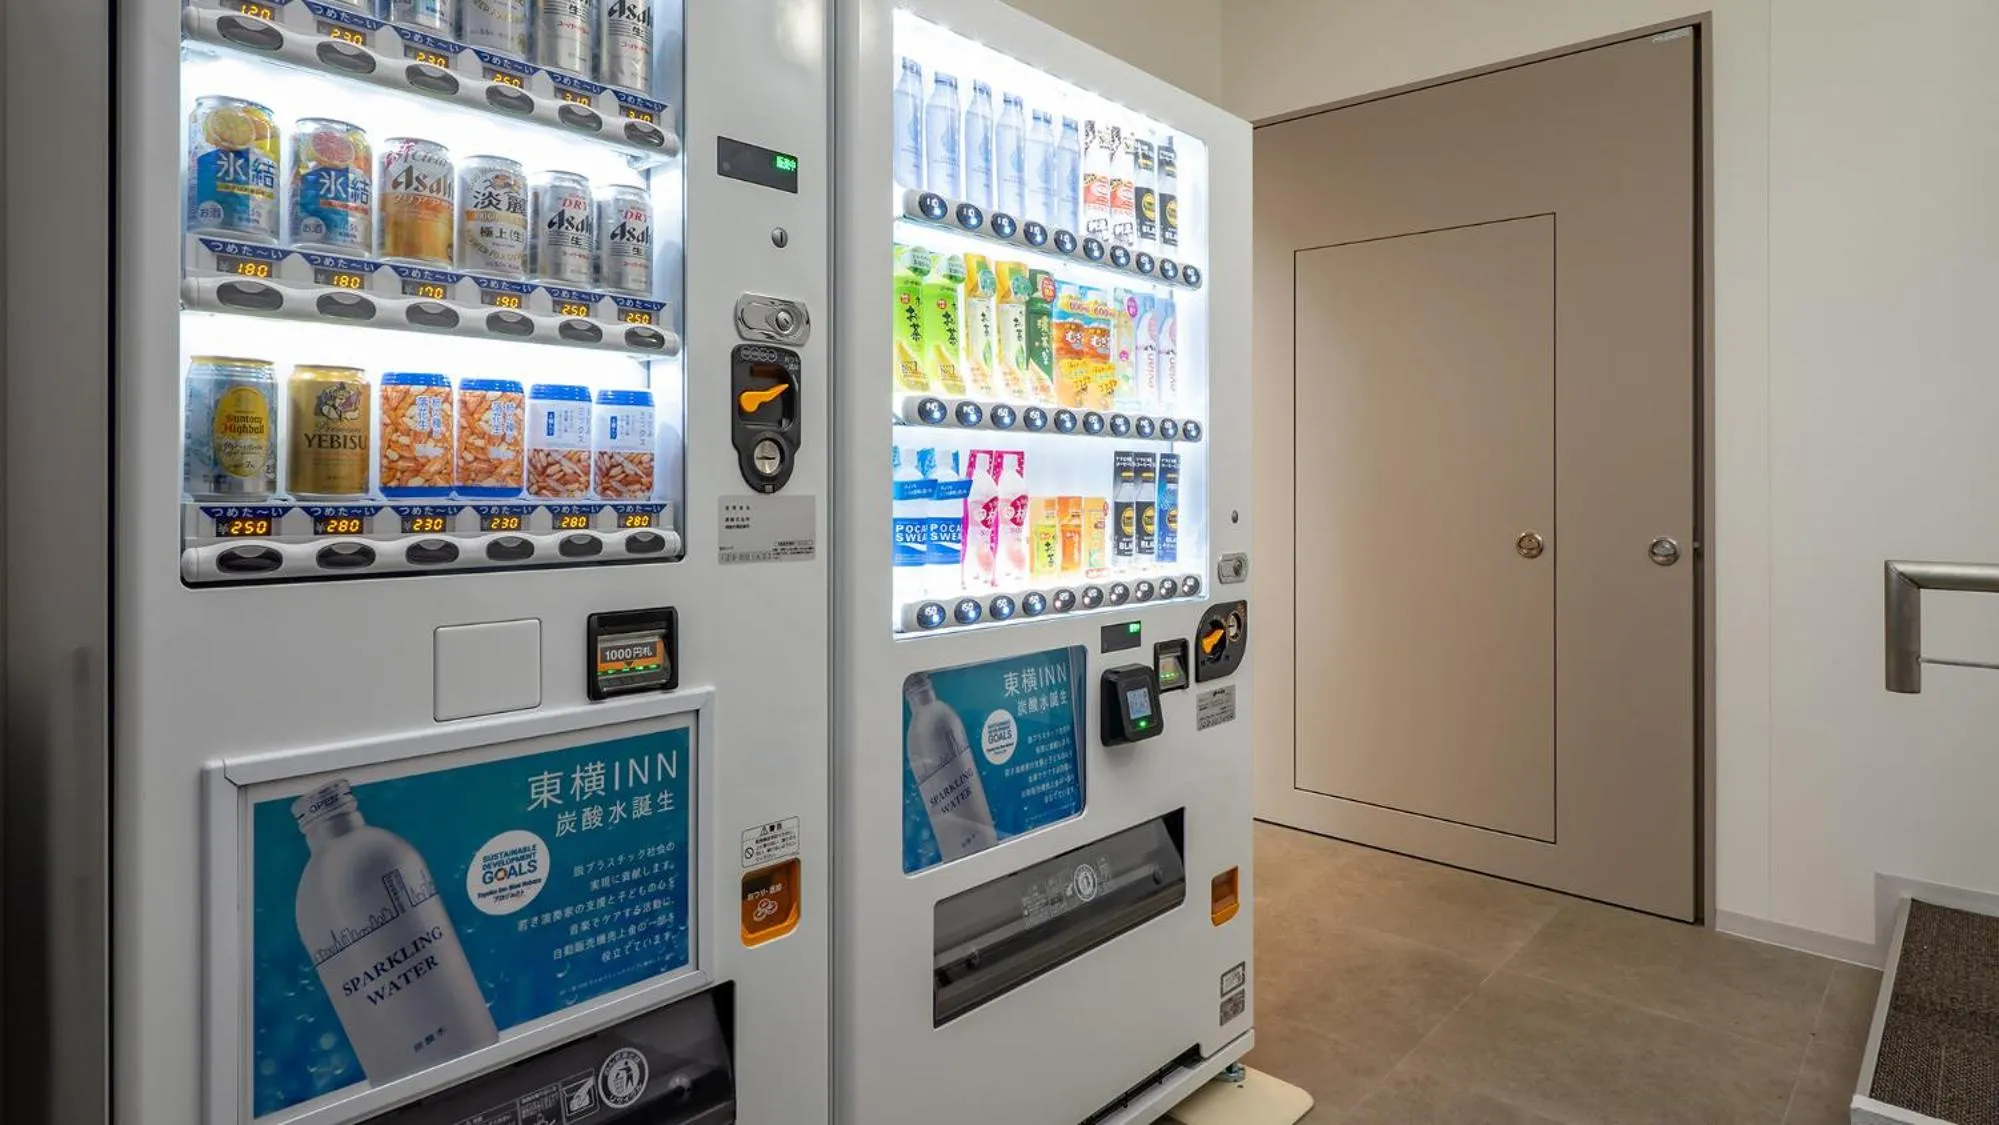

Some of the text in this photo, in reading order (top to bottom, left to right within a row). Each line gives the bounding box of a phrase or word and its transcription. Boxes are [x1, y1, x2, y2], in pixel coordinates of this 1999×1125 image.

[216, 152, 276, 188] 氷結
[319, 170, 369, 204] 氷結
[238, 262, 269, 278] 180
[333, 275, 361, 289] 180
[496, 296, 520, 308] 190
[561, 304, 587, 317] 250
[626, 312, 649, 324] 250
[303, 433, 368, 450] YEBISU
[604, 646, 652, 661] 1000円札
[555, 789, 675, 838] 炭酸水誕生
[482, 859, 538, 885] GOALS
[342, 926, 443, 997] SPARKLING
[367, 955, 438, 1006] WATER
